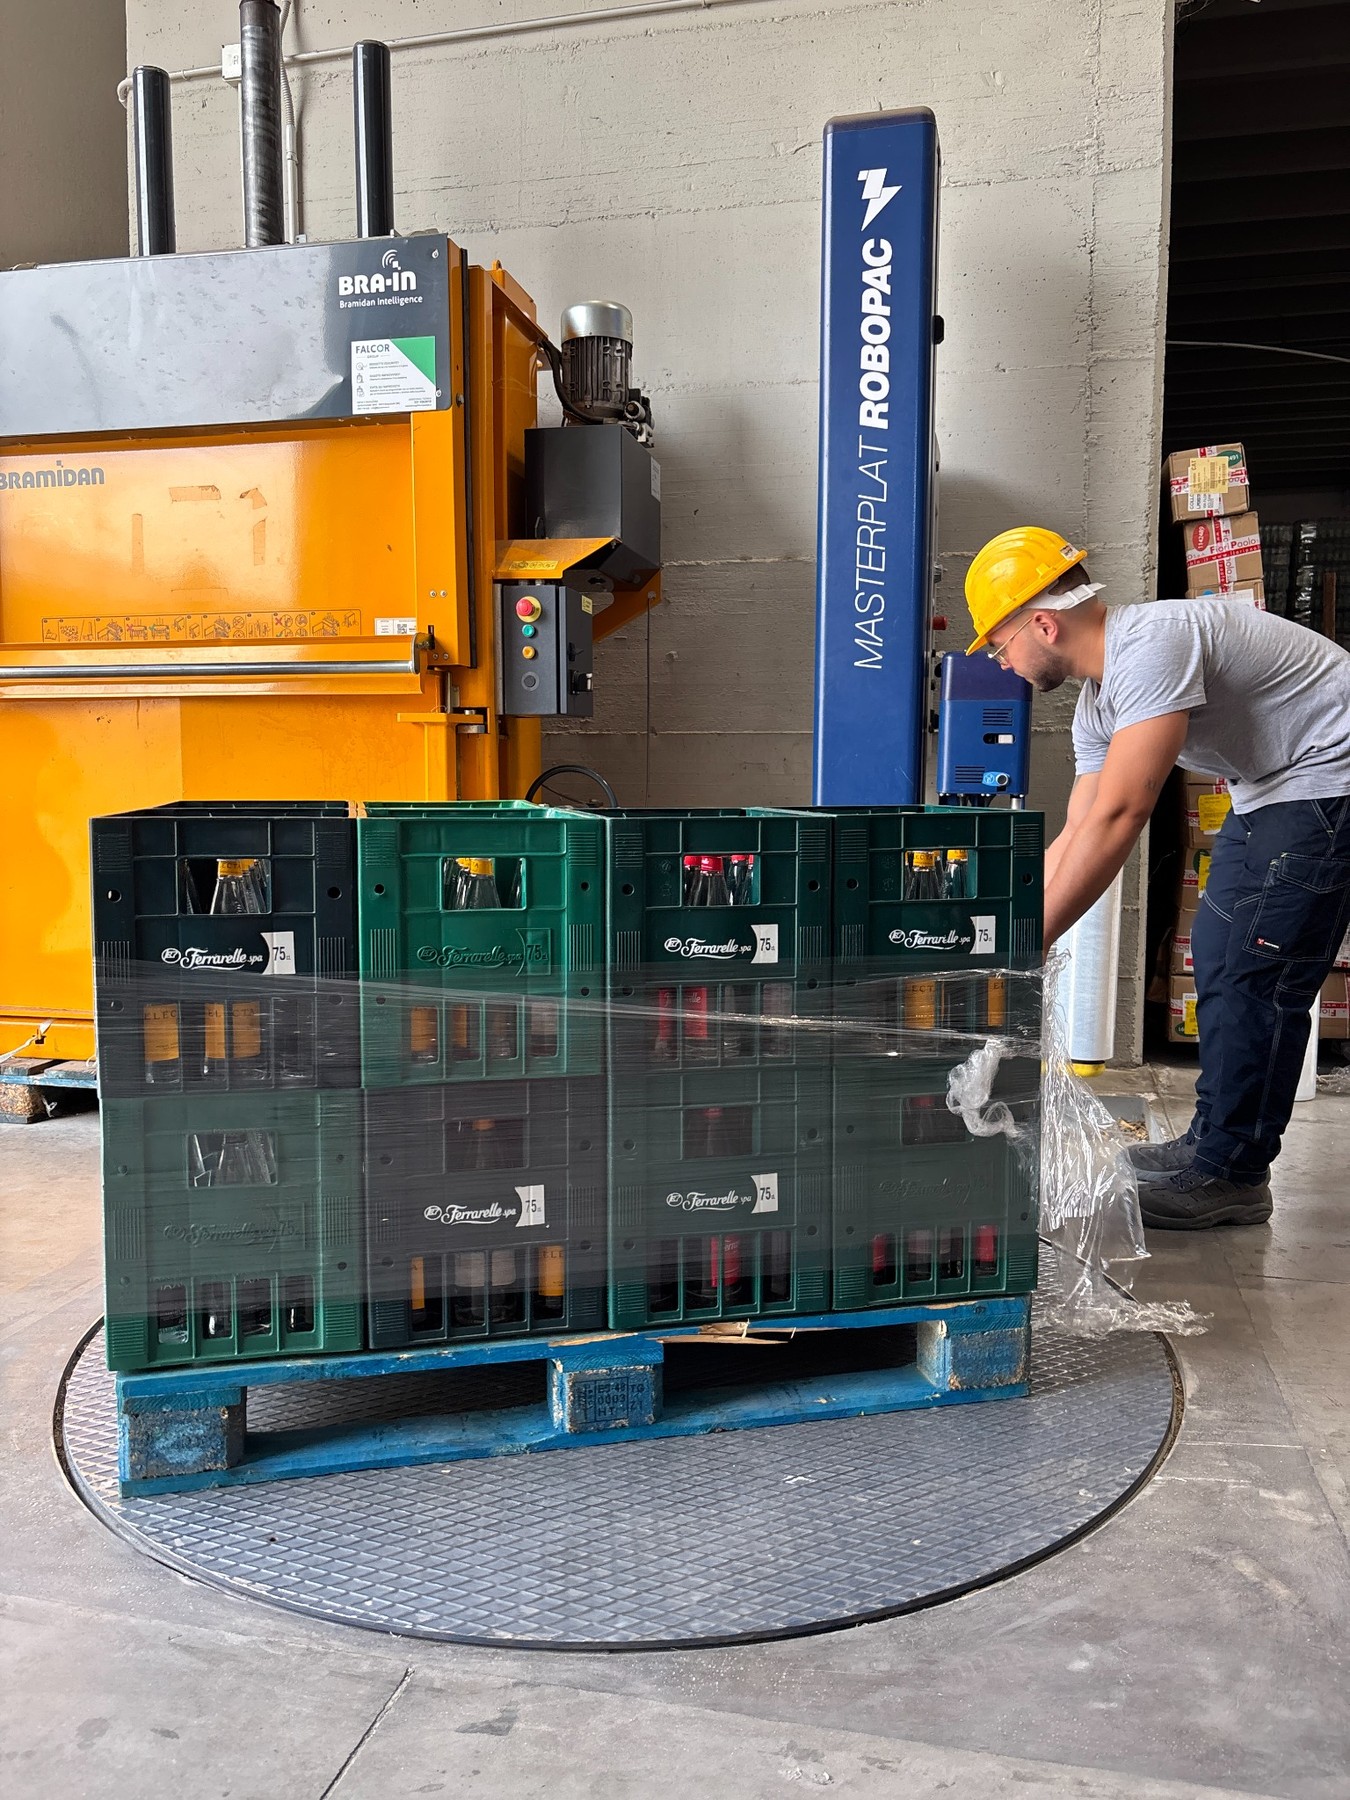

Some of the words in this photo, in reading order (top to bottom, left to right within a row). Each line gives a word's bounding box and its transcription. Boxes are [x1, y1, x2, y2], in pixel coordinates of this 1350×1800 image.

[339, 298, 376, 309] Bramidan
[377, 295, 423, 306] Intelligence
[859, 238, 893, 429] ROBOPAC
[355, 343, 390, 354] FALCOR
[854, 435, 888, 669] MASTERPLAT
[180, 947, 247, 970] Ferrarelle
[436, 945, 506, 969] Ferrarelle
[681, 937, 738, 959] Ferrarelle
[682, 1190, 738, 1212] Ferrarelle
[441, 1201, 502, 1225] Ferrarelle
